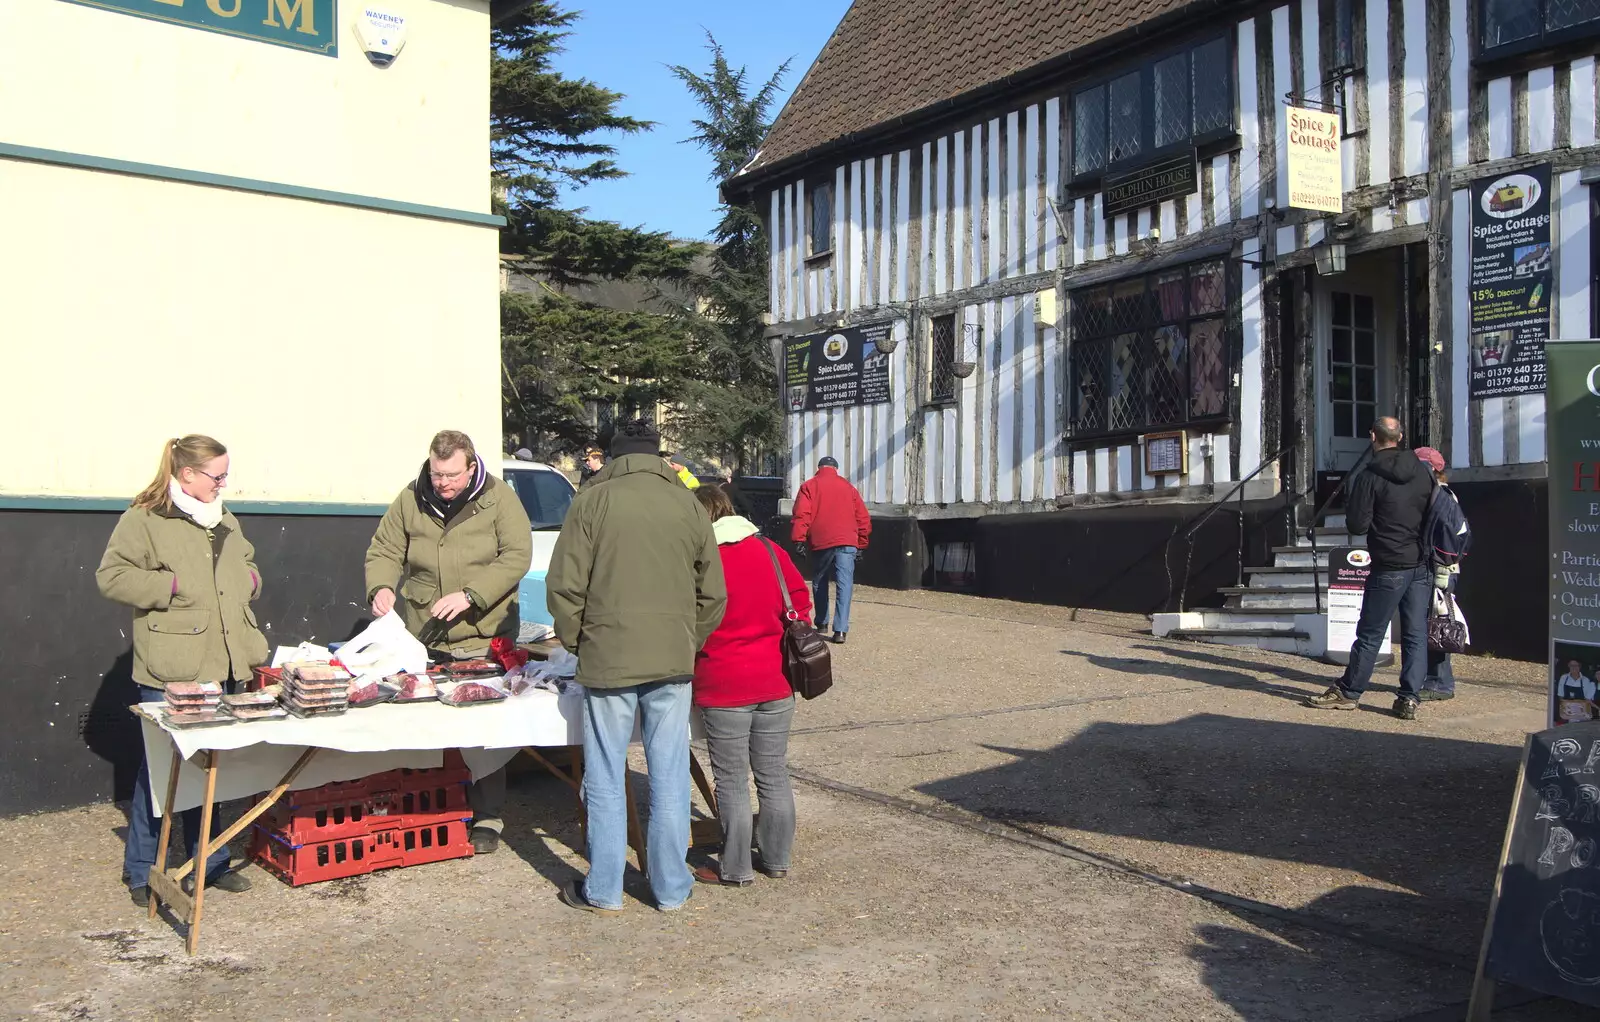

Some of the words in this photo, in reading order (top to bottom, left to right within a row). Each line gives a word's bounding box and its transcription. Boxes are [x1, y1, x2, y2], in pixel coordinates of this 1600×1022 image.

[365, 10, 404, 24] WAVENEY
[1290, 113, 1324, 133] Spice
[1290, 130, 1338, 152] Cottage
[1107, 178, 1153, 203] DOLPHIN
[1156, 167, 1191, 187] HOUSE
[1473, 223, 1503, 238] Spice
[1505, 214, 1550, 231] Cottage
[1486, 234, 1510, 243] Exclusive
[1510, 230, 1529, 238] Indian
[1486, 240, 1512, 249] Nepalese
[1513, 236, 1534, 244] Cuisine
[1473, 253, 1500, 263] Restaurant
[1485, 267, 1508, 276] Licensed
[1480, 274, 1512, 284] Conditioned
[1472, 288, 1494, 301] 15%
[1497, 286, 1526, 298] Discount
[818, 365, 832, 375] Spice
[833, 362, 854, 372] Cottage
[1473, 371, 1486, 379] Tel:
[1487, 367, 1512, 378] 01379
[1514, 365, 1530, 374] 640
[823, 384, 838, 392] 01379
[848, 381, 857, 389] 222
[1486, 377, 1512, 387] 01379
[1513, 375, 1530, 384] 640
[823, 392, 838, 400] 01379
[1568, 519, 1600, 533] slow
